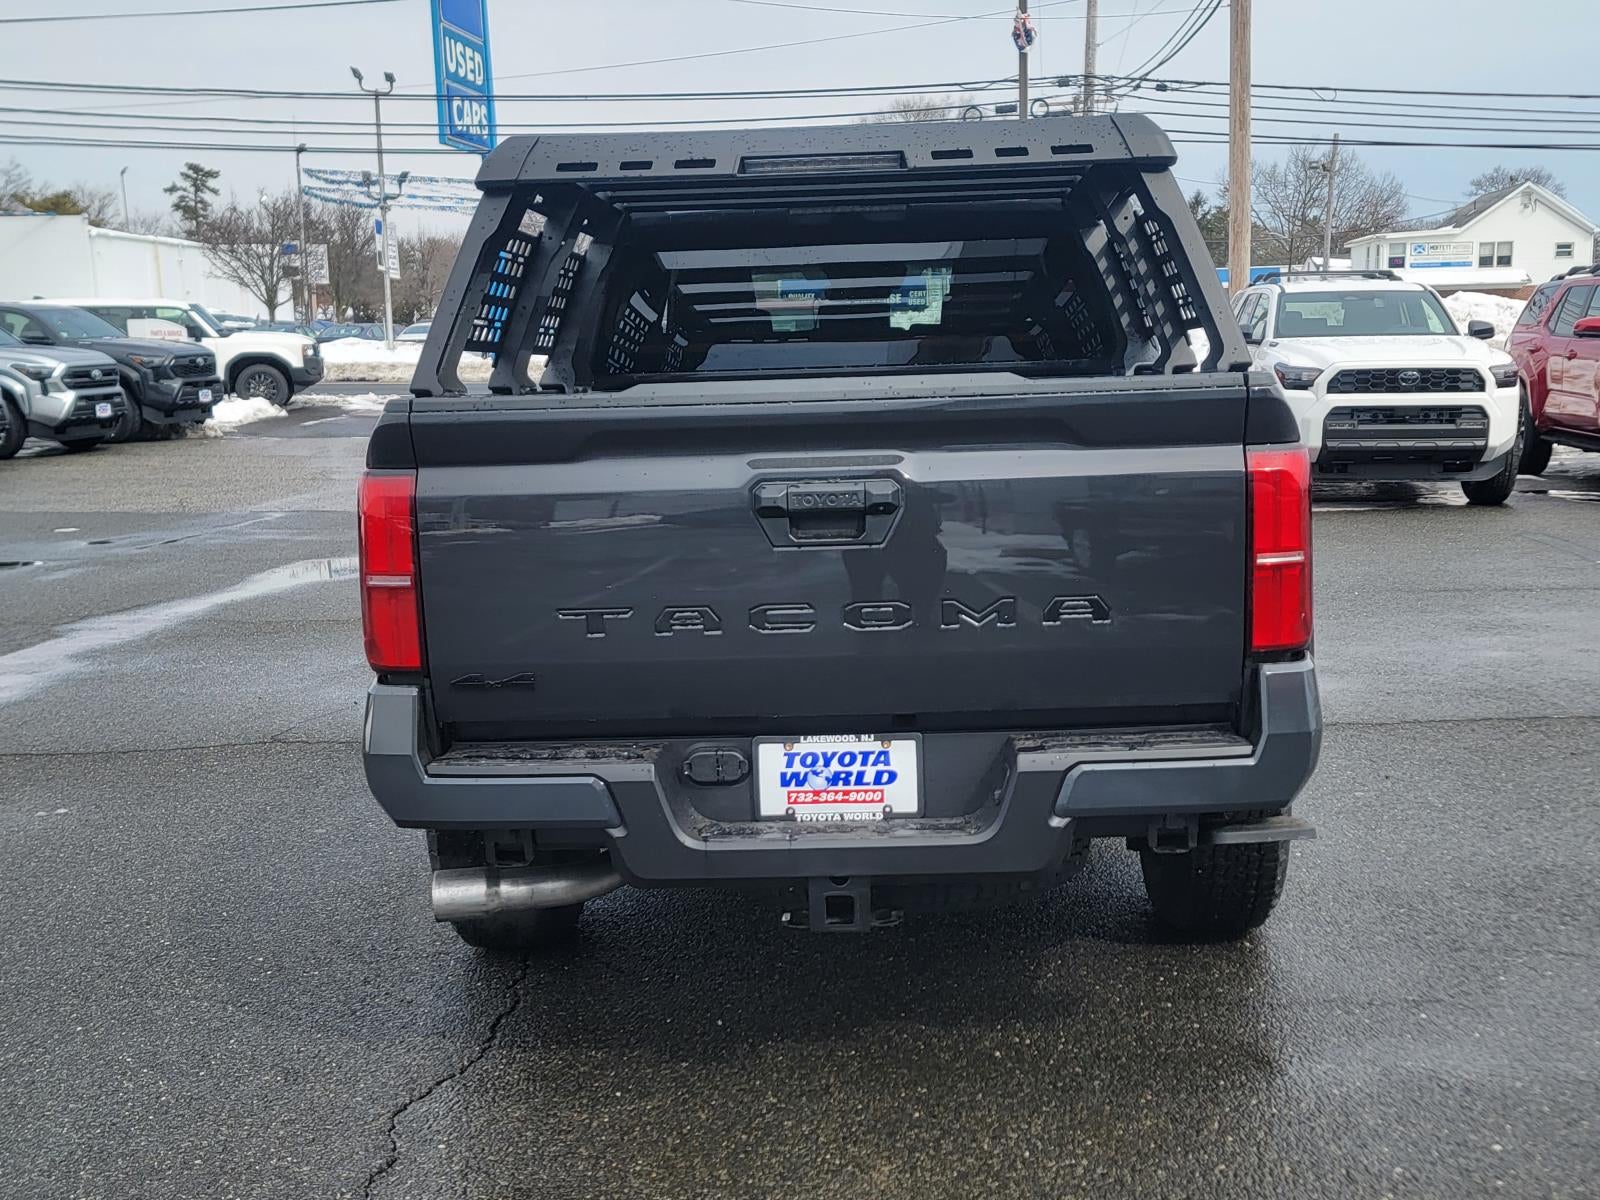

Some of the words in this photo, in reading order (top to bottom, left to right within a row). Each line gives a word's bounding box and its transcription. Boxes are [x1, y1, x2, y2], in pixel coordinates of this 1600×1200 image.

[445, 36, 484, 86] USED
[453, 97, 489, 139] CARS
[908, 298, 926, 306] USED
[791, 492, 862, 507] TOYOTA
[556, 595, 1112, 638] TACOMA
[861, 734, 874, 742] NJ
[784, 750, 891, 768] TOYOTA
[780, 769, 898, 788] WORLD
[789, 791, 882, 802] 732-364-9000
[795, 812, 841, 822] TOYOTA
[843, 812, 884, 821] WORLD
